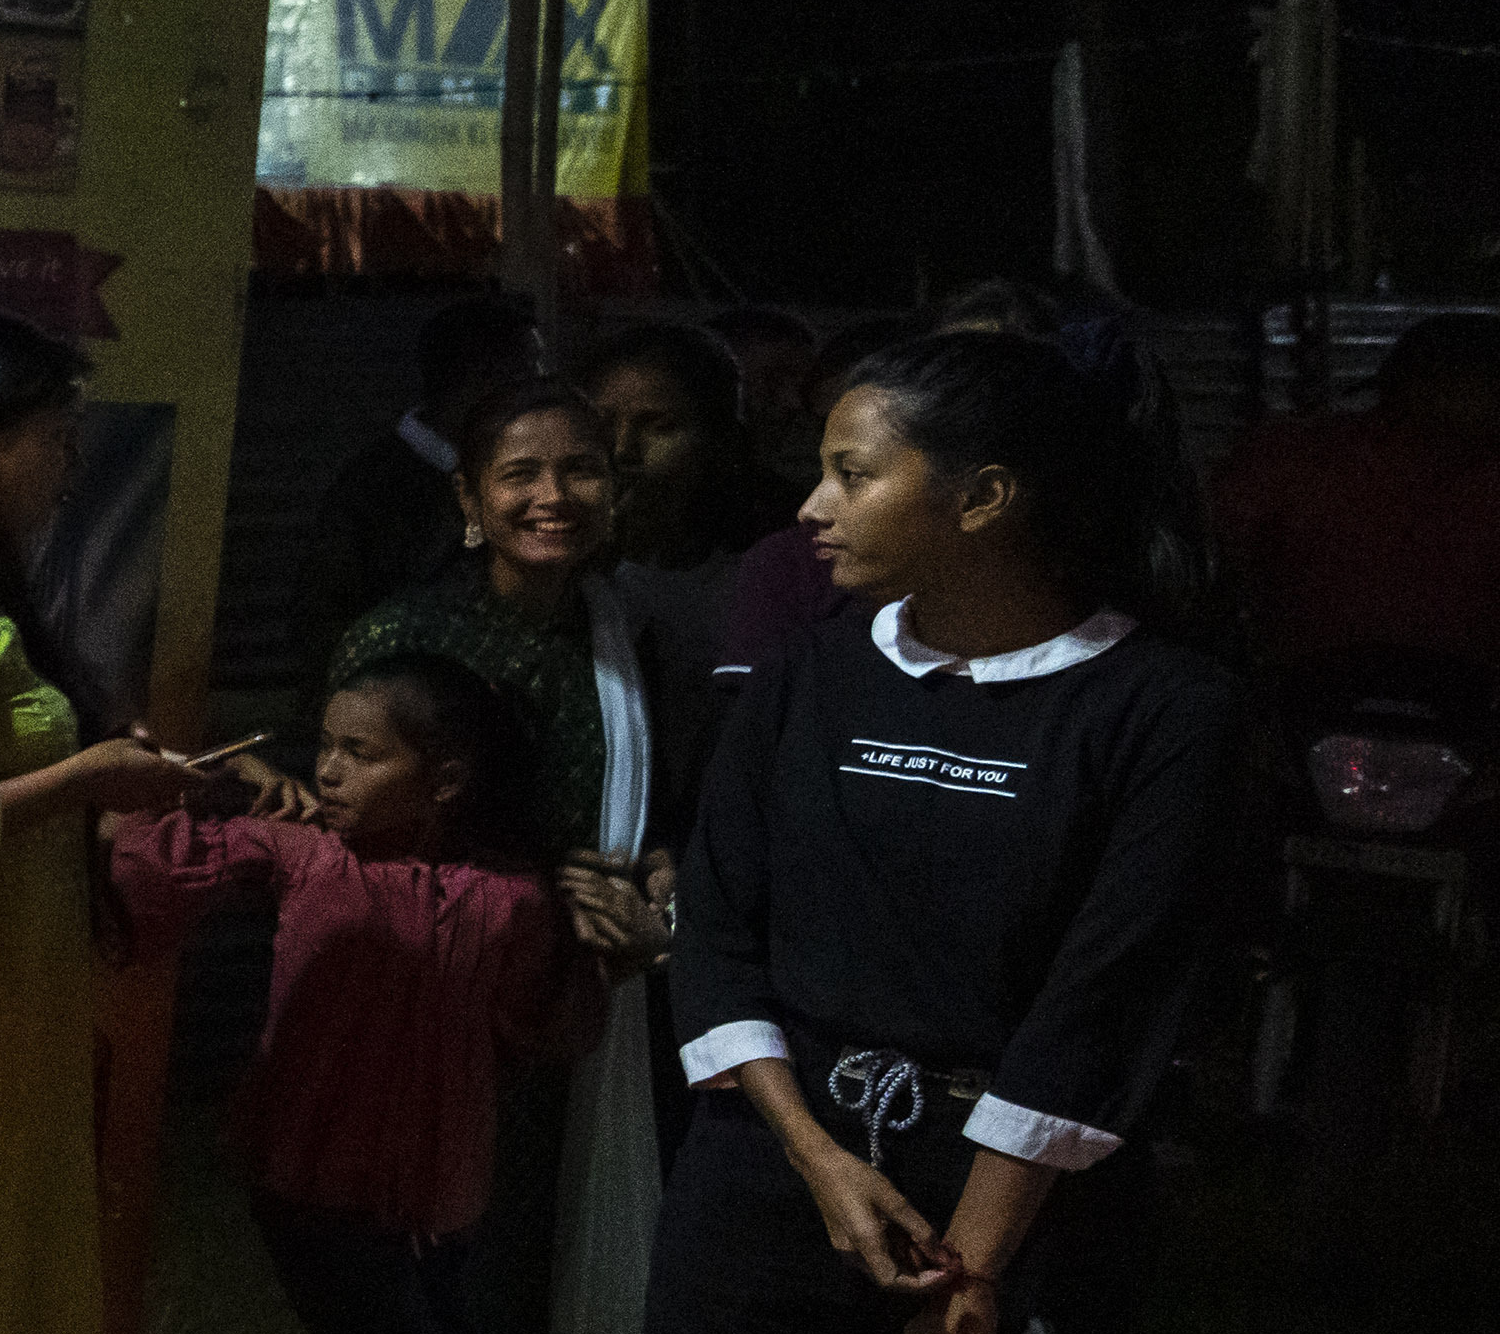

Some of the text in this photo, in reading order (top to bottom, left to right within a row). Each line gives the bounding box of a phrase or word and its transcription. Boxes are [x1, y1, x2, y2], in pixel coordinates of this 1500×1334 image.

[38, 252, 64, 283] it
[904, 756, 939, 770] JUST
[940, 762, 974, 781] FOR
[977, 769, 1009, 784] YOU
